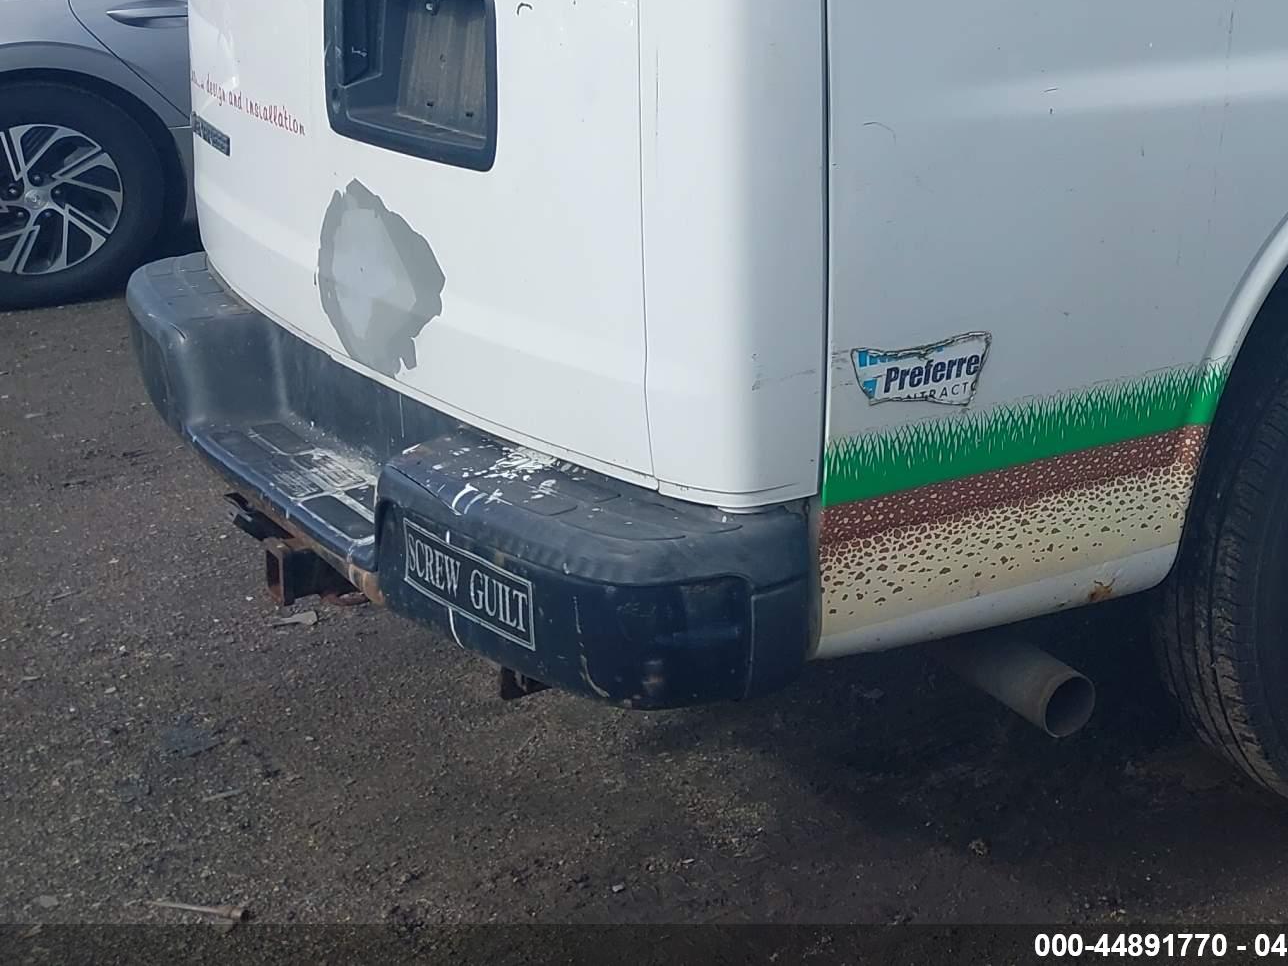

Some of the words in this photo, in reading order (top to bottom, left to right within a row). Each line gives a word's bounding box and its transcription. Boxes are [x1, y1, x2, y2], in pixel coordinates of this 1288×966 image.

[228, 91, 243, 111] and
[245, 97, 305, 136] installation
[883, 353, 980, 394] Preferre
[408, 533, 460, 598] SCREW
[470, 569, 528, 633] GUILT
